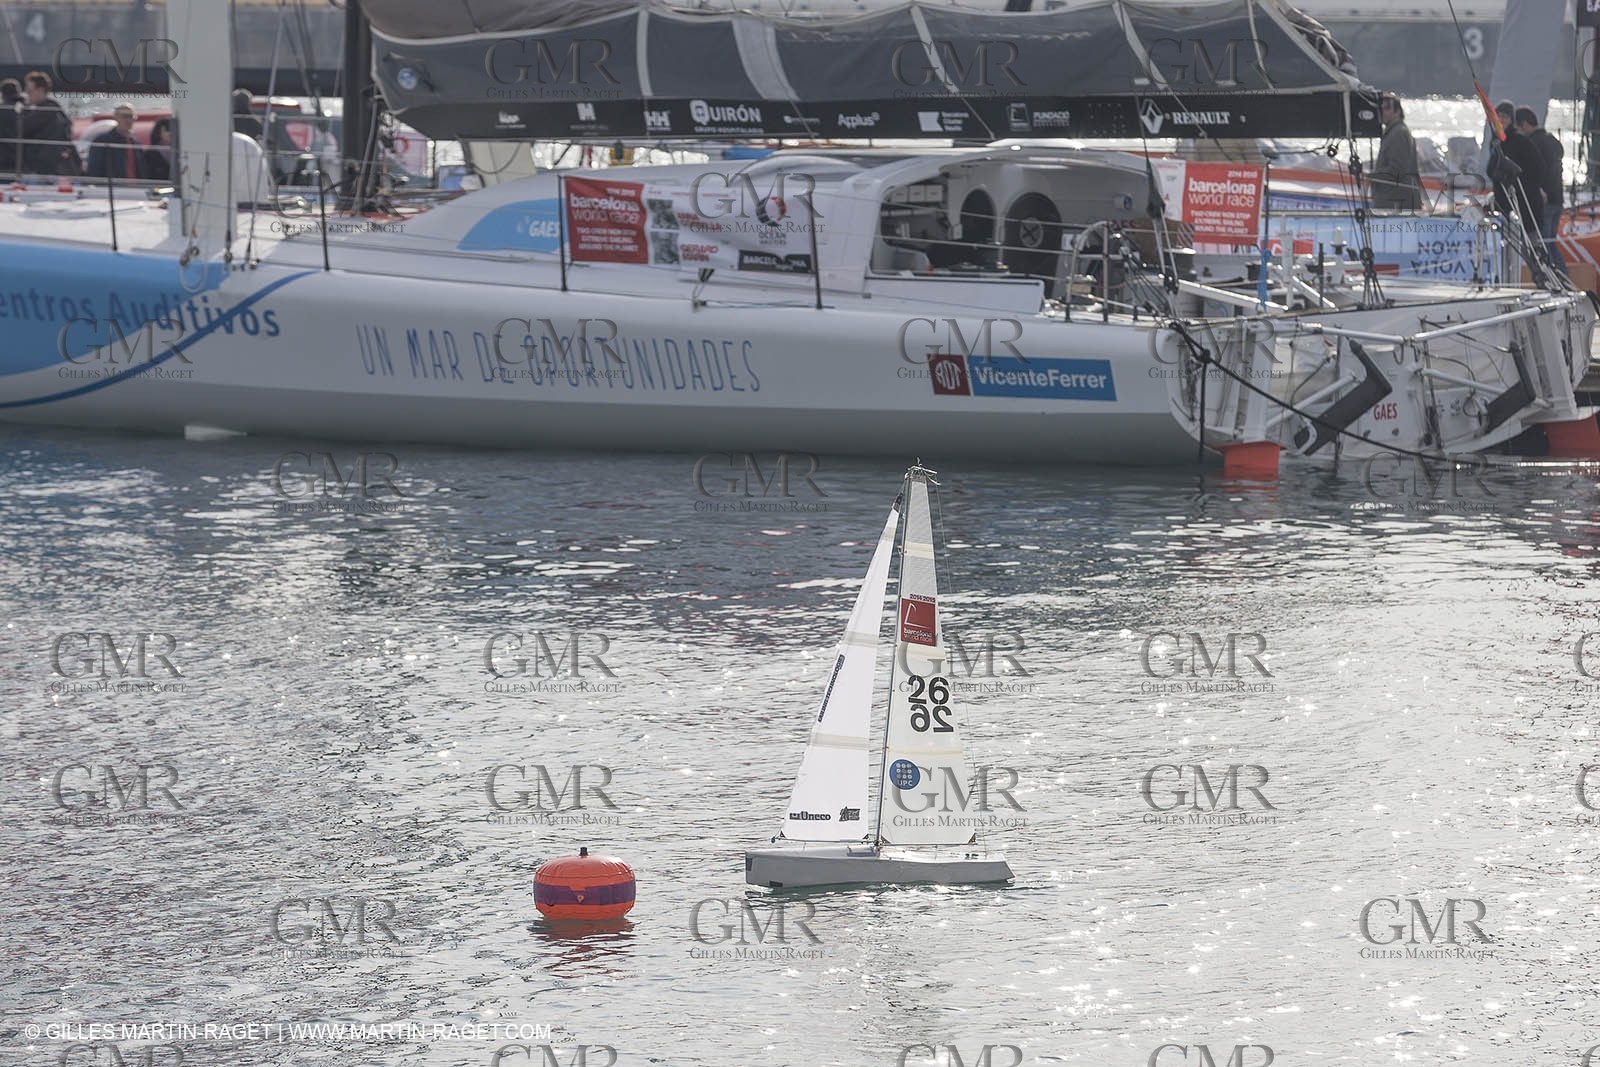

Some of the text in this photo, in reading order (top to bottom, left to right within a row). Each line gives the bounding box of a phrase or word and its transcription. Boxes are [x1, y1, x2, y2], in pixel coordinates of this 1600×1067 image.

[1464, 27, 1485, 60] 3
[690, 100, 762, 125] QUIRÓN
[1172, 112, 1230, 125] RENAULT
[1188, 177, 1256, 196] barcelona
[570, 192, 640, 212] barcelona
[1188, 193, 1256, 208] world race
[1411, 259, 1466, 275] VOLTA
[109, 290, 281, 337] Auditivos
[355, 323, 395, 377] UN
[407, 328, 464, 381] MAR
[975, 365, 1107, 389] VicenteFerrer
[1373, 402, 1398, 421] GAES
[908, 674, 950, 705] 26
[896, 779, 914, 787] UPC
